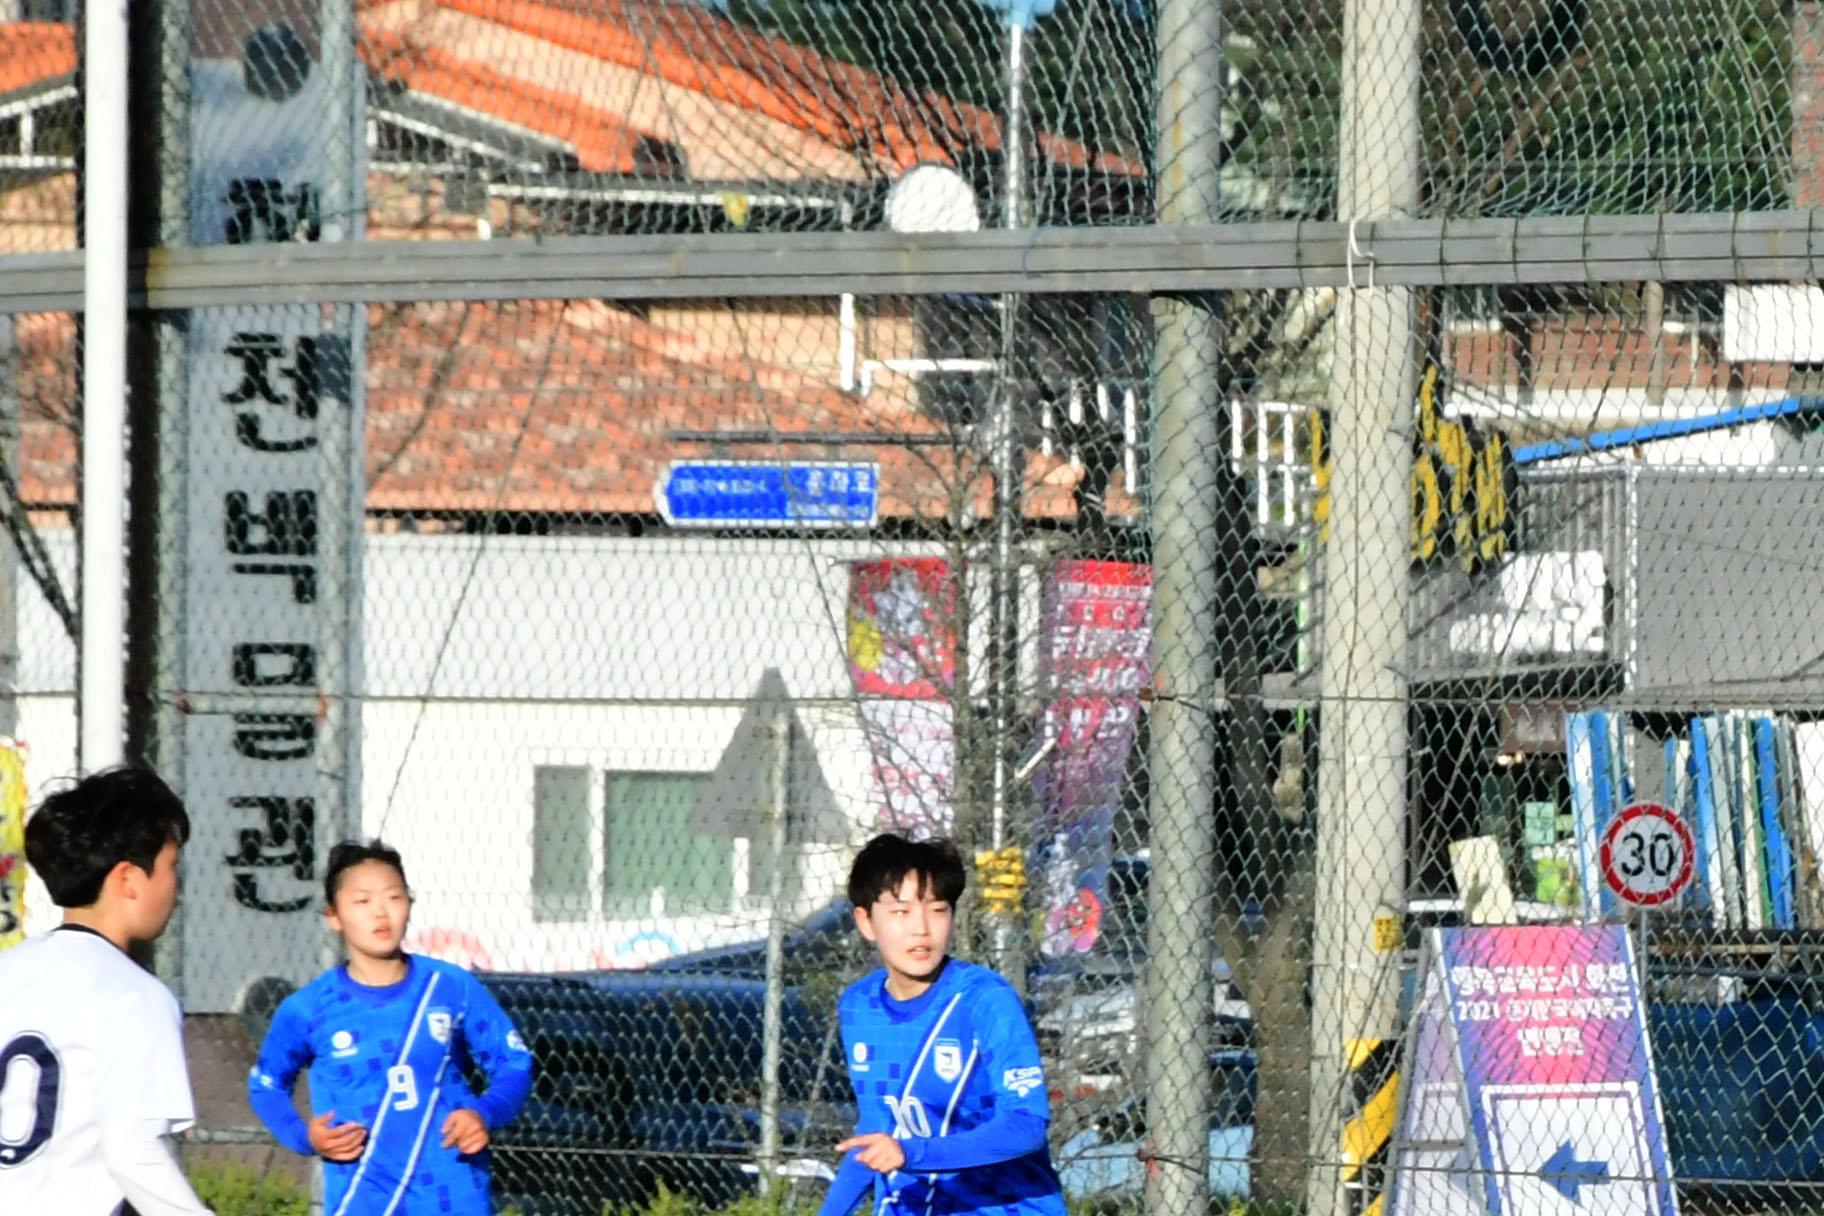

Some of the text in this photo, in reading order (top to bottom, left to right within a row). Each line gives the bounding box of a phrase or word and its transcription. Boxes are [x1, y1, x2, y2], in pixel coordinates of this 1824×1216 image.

[1621, 832, 1675, 876] 30
[1456, 1000, 1500, 1021] 2021
[387, 1064, 419, 1112] 9
[884, 1096, 932, 1140] 10
